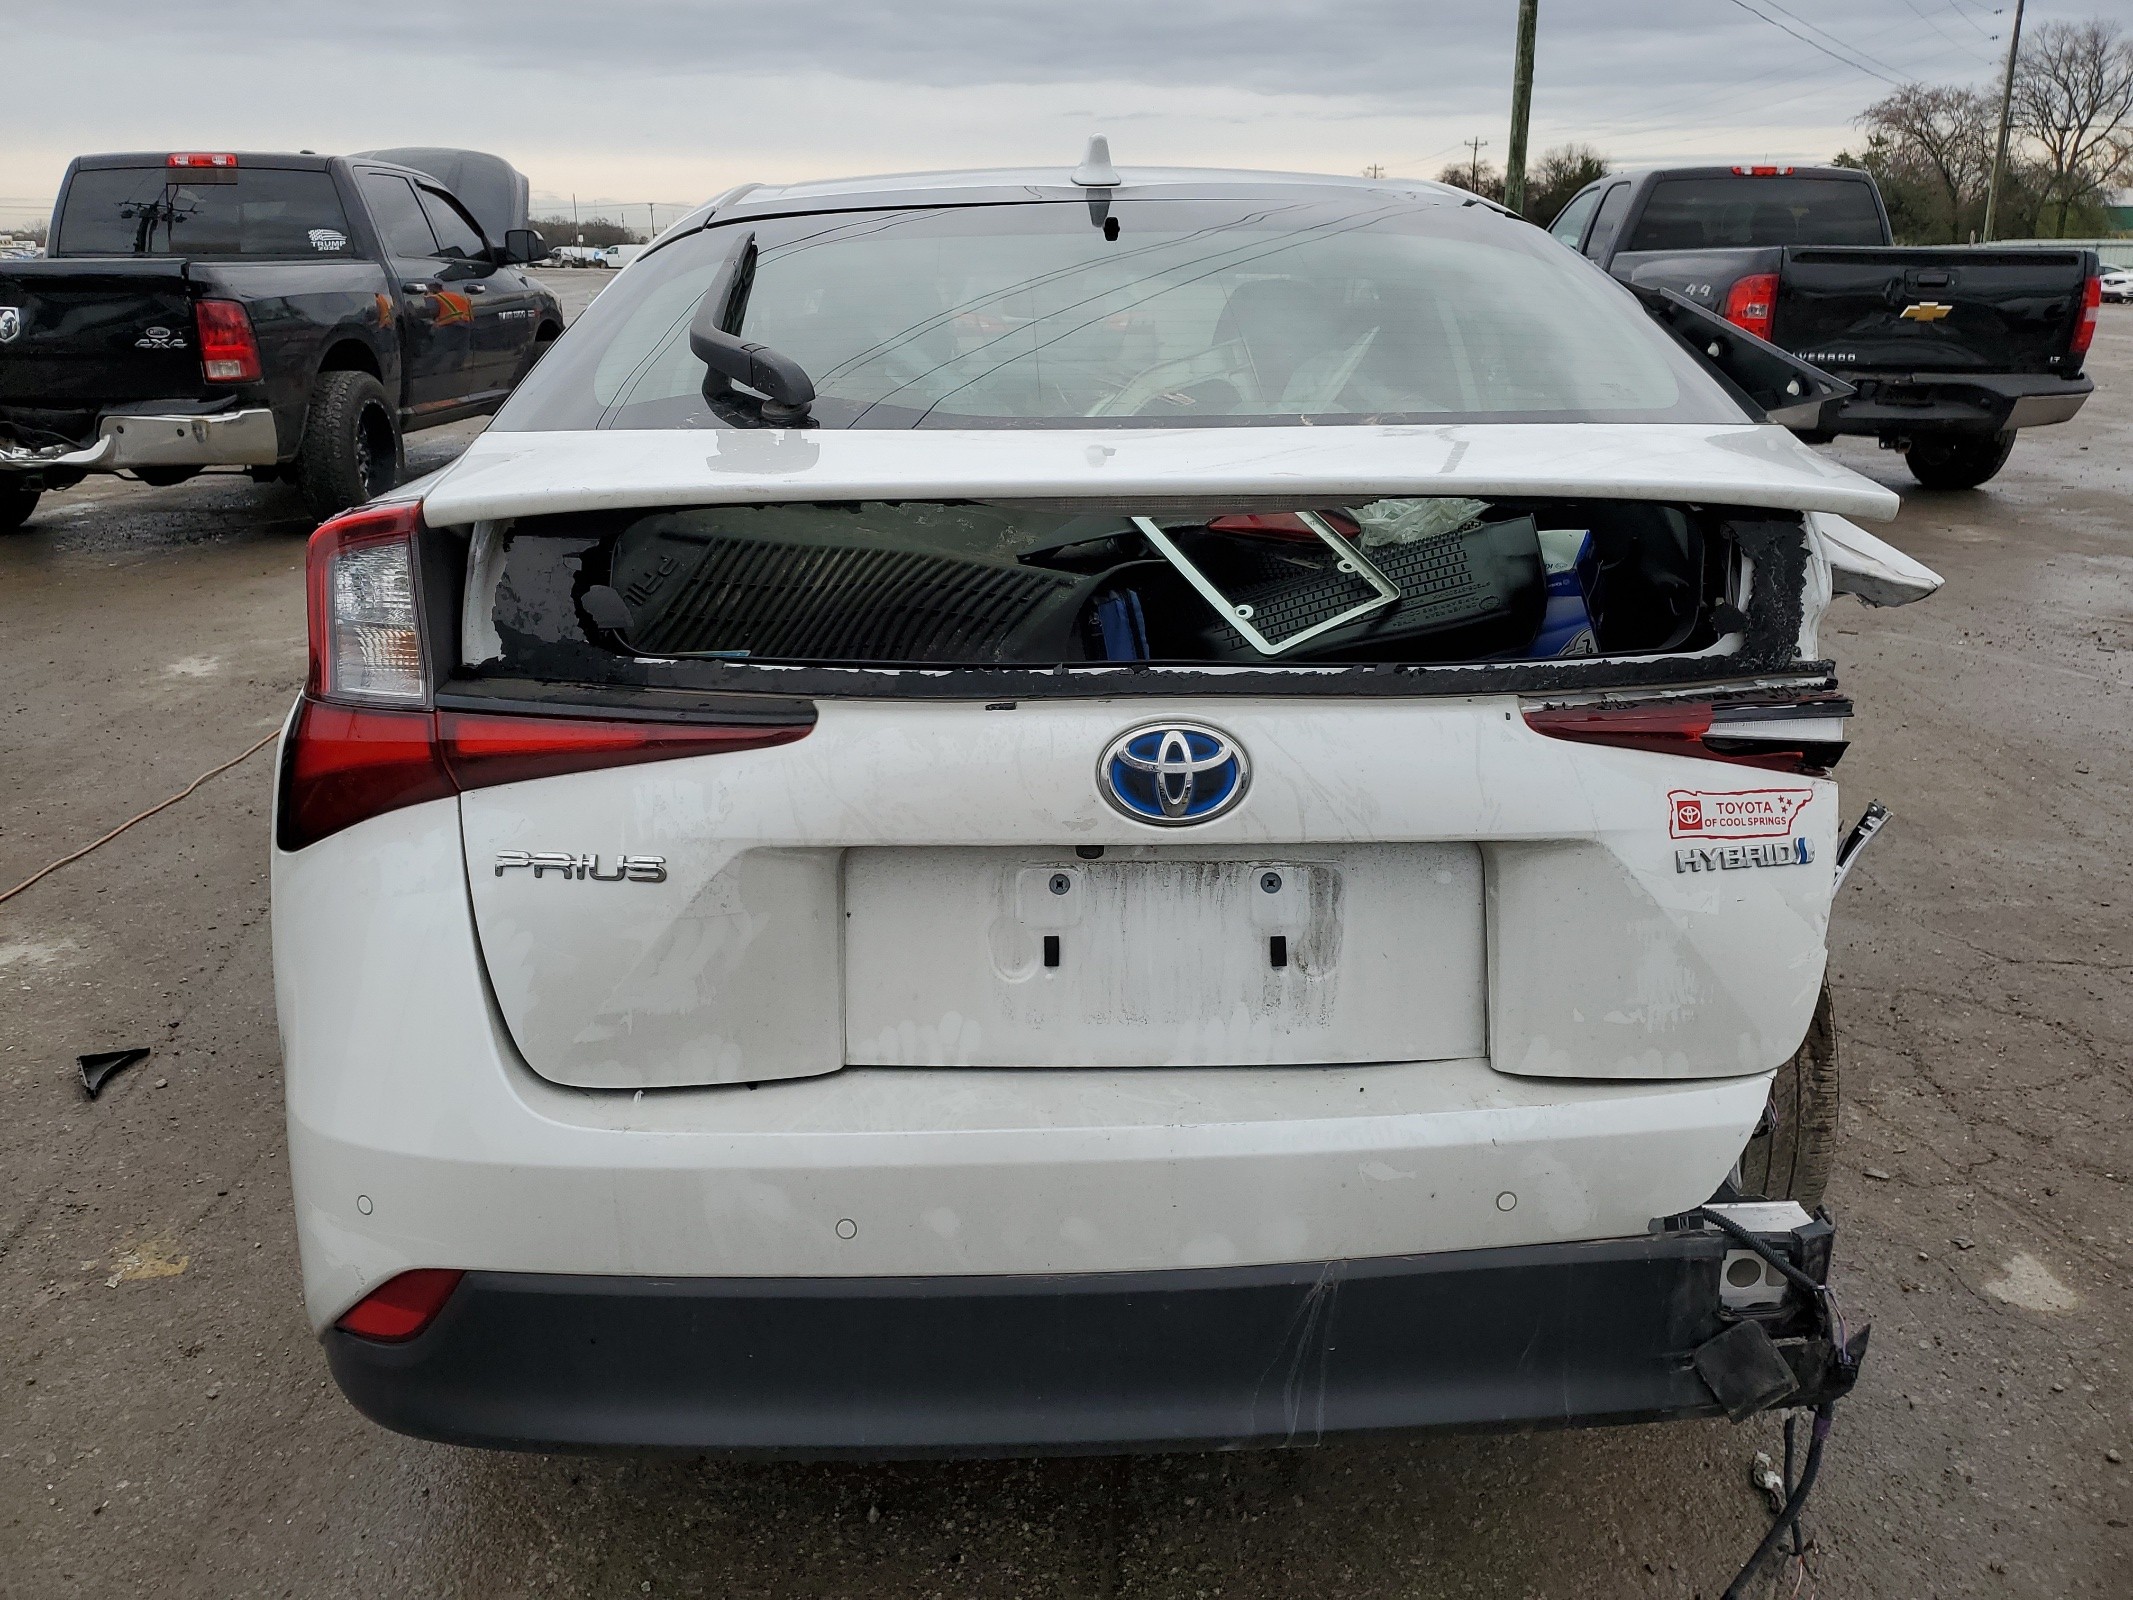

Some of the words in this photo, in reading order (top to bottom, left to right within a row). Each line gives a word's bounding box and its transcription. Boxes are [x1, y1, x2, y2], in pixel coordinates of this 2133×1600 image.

[1716, 802, 1774, 815] TOYOTA
[1704, 818, 1718, 827] OF
[494, 850, 668, 883] PRIUS
[1675, 842, 1795, 873] HYBRID
